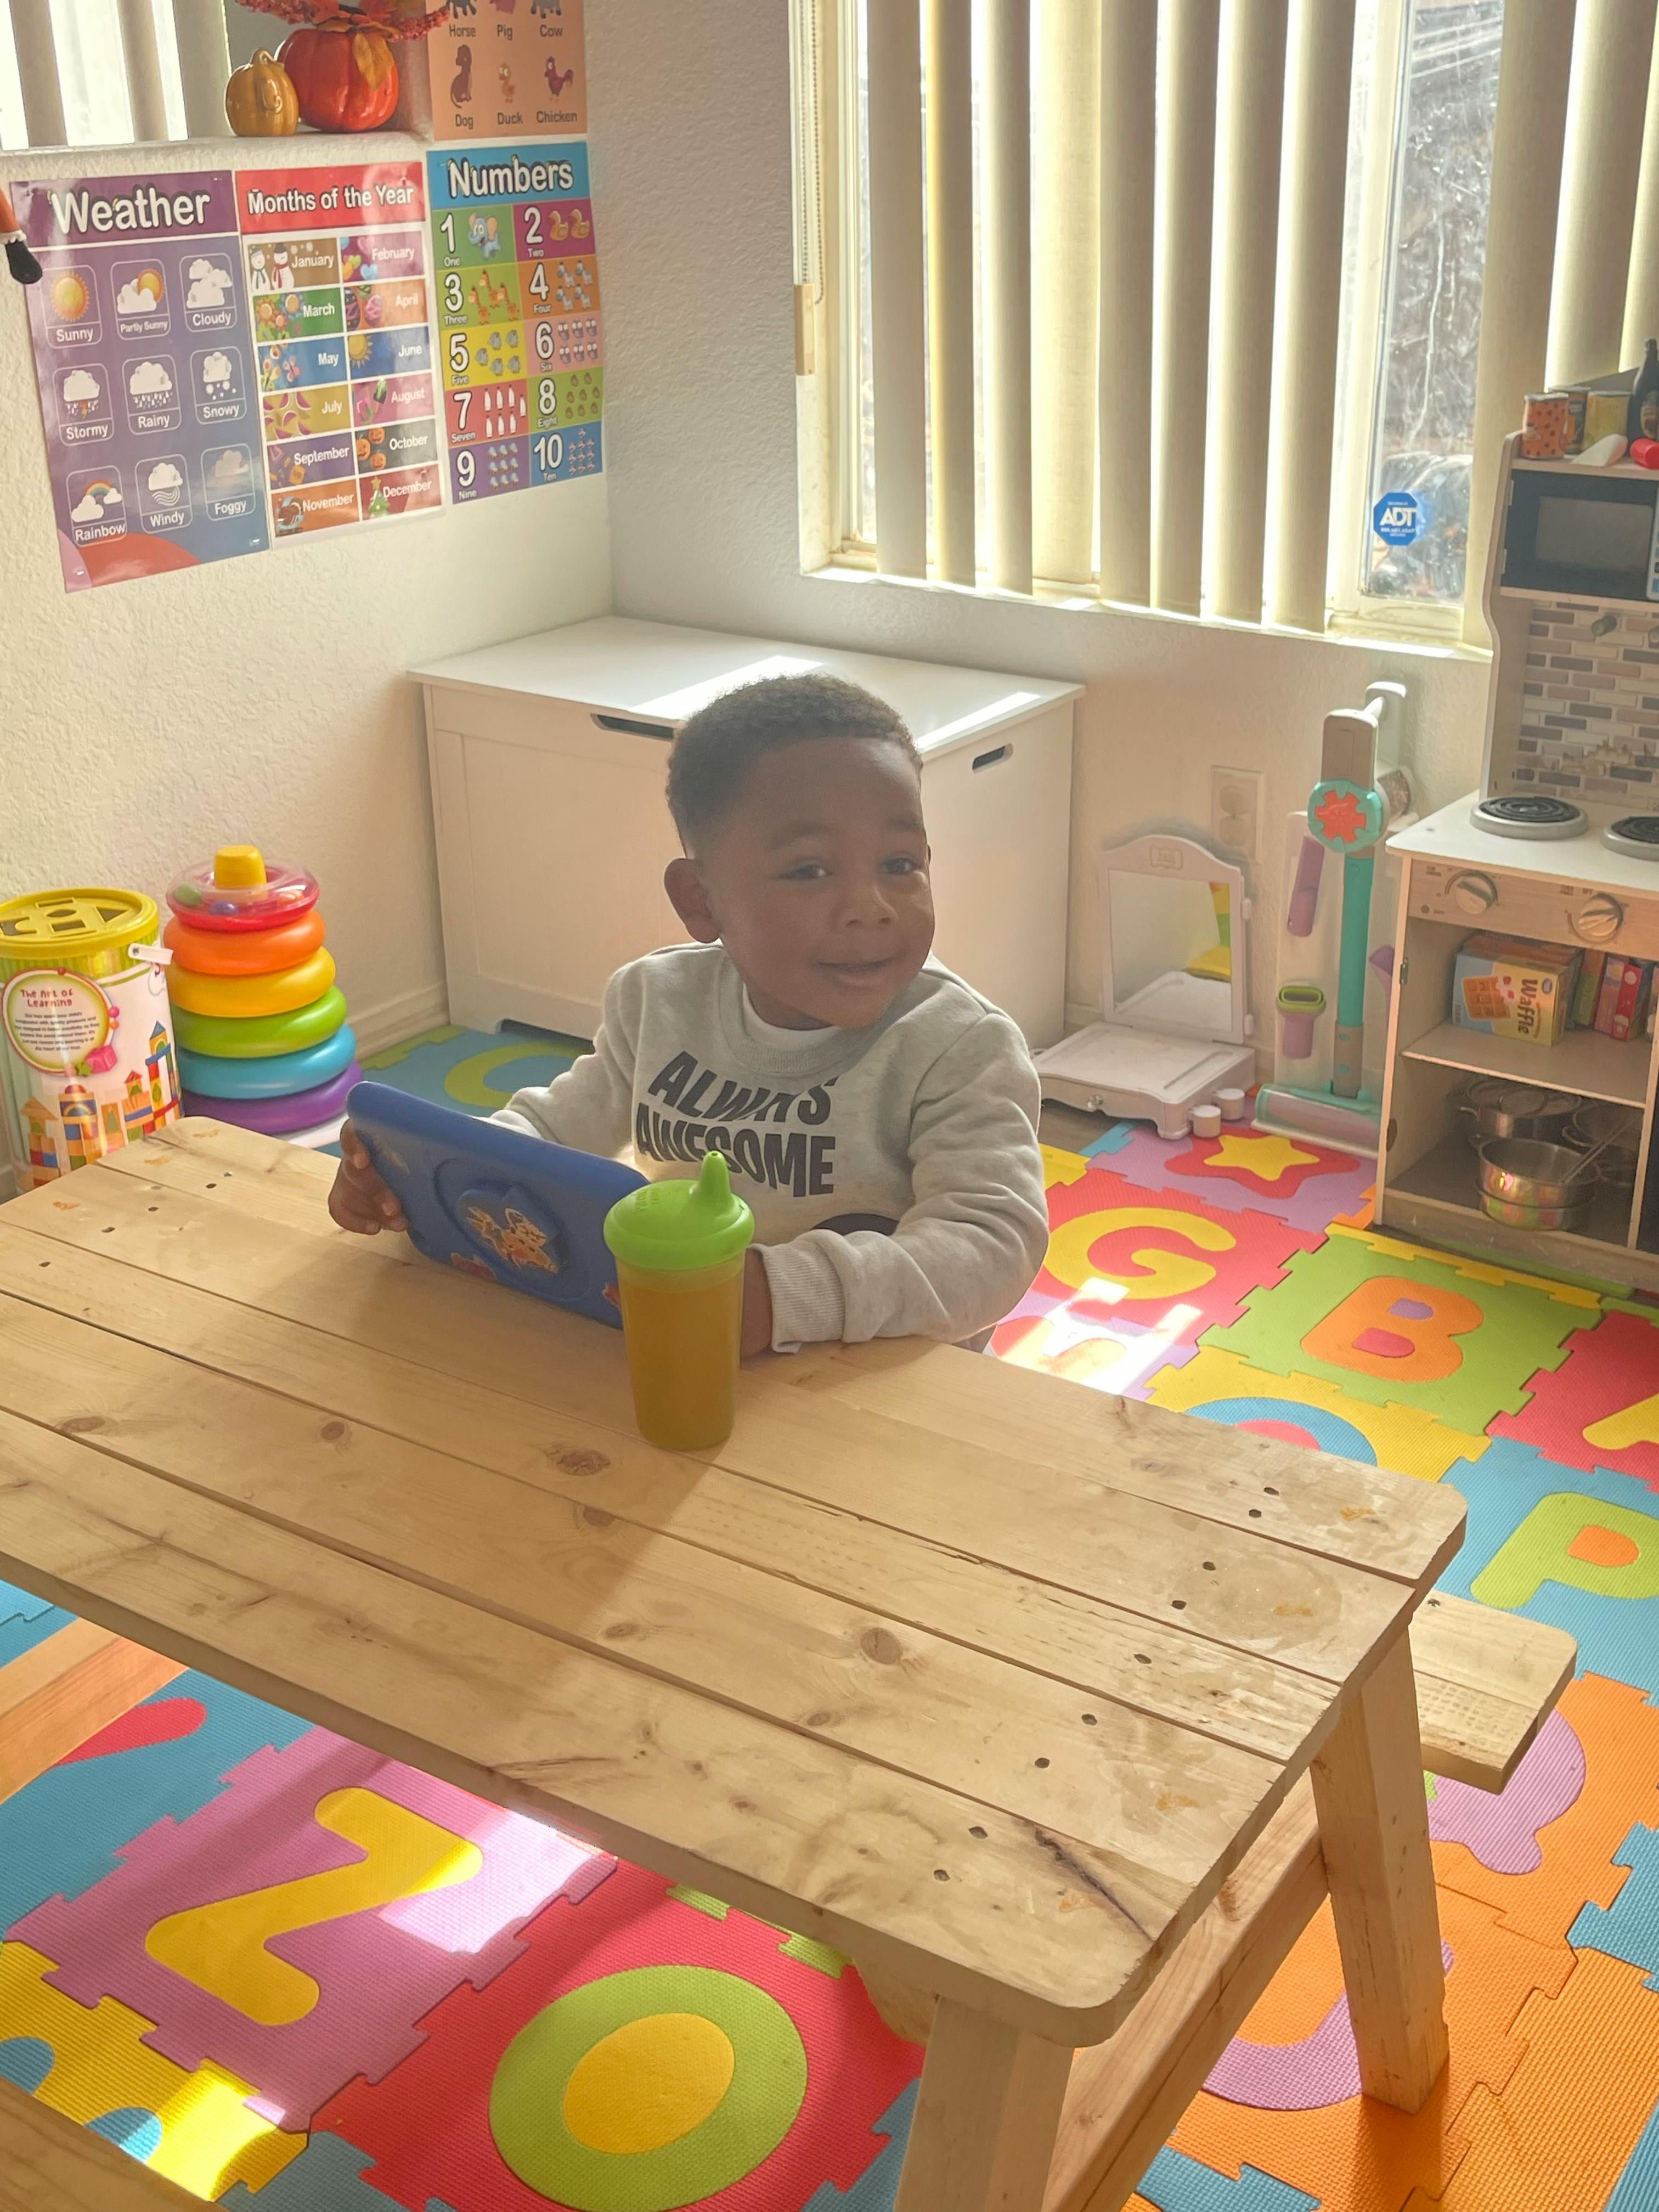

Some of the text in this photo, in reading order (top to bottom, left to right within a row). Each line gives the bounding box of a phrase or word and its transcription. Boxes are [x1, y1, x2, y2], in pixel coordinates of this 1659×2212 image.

[449, 24, 476, 37] Horse
[497, 24, 513, 40] Pig
[540, 24, 563, 37] Cow
[455, 114, 473, 129] Dog
[498, 112, 523, 125] Duck
[537, 111, 577, 123] Chicken
[448, 157, 574, 198] Numbers
[249, 184, 414, 214] Months of the Year
[50, 185, 212, 235] Weather
[524, 206, 544, 244] 2
[441, 213, 455, 253] 1
[372, 247, 415, 261] February
[528, 248, 544, 257] Two
[291, 255, 334, 269] January
[444, 257, 460, 266] One
[529, 263, 549, 301] 4
[444, 273, 464, 312] 3
[396, 294, 419, 307] April
[533, 303, 552, 313] Four
[303, 303, 335, 318] March
[120, 319, 168, 334] Partly Sunny
[193, 312, 232, 327] Cloudy
[444, 315, 468, 325] Three
[57, 329, 94, 343] Sunny
[535, 321, 554, 359] 6
[398, 345, 422, 357] June
[450, 334, 470, 373] 5
[318, 353, 339, 366] May
[452, 375, 469, 385] Five
[391, 387, 425, 404] August
[538, 378, 556, 415] 8
[204, 404, 239, 420] Snowy
[322, 401, 343, 415] July
[453, 391, 472, 430] 7
[138, 415, 170, 428] Rainy
[537, 416, 557, 428] Eight
[66, 425, 109, 440] Stormy
[452, 432, 476, 443] Seven
[389, 435, 428, 450] October
[294, 447, 349, 466] September
[534, 433, 563, 471] 10
[457, 450, 476, 487] 9
[543, 473, 556, 482] Ten
[383, 479, 432, 498] December
[459, 489, 477, 500] Nine
[215, 500, 247, 515] Foggy
[302, 494, 354, 512] November
[150, 511, 184, 527] Windy
[1379, 507, 1418, 527] ADT
[75, 523, 126, 542] Rainbow
[20, 989, 36, 998] The
[41, 989, 58, 997] Art
[27, 998, 72, 1007] Learning
[1517, 978, 1538, 1035] Waffle
[648, 1051, 839, 1125] ALWAS
[636, 1103, 836, 1198] AWESOME
[1300, 1276, 1484, 1383] B
